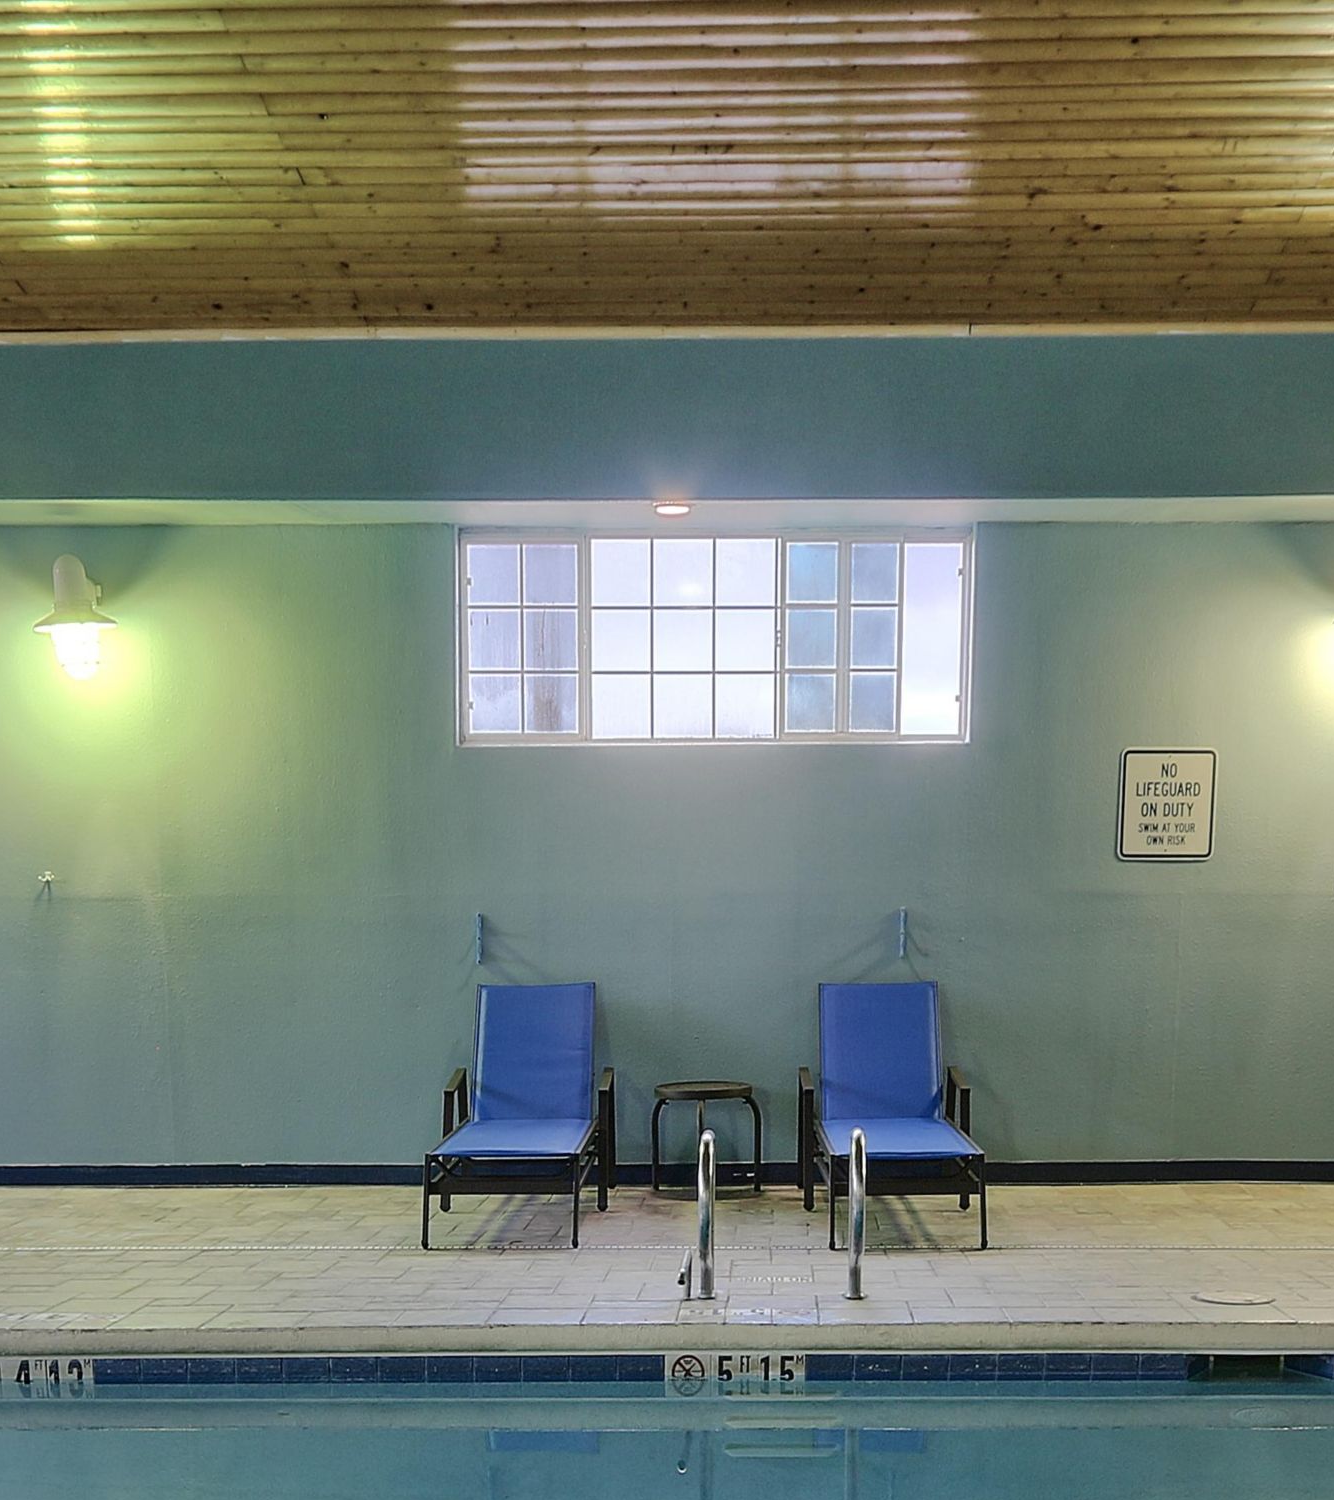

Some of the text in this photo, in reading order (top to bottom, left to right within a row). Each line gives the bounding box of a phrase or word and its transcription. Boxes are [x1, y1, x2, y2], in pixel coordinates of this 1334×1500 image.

[1161, 763, 1178, 778] NO
[1136, 782, 1201, 797] LIFEGUARD
[1140, 802, 1194, 817] ON DUTY
[1138, 823, 1195, 833] SWIM AT YOUR
[1146, 835, 1186, 845] OWN RISK
[34, 1360, 43, 1370] FT
[84, 1359, 91, 1368] M
[718, 1356, 732, 1381] 5
[740, 1356, 751, 1373] FT
[796, 1355, 803, 1364] M
